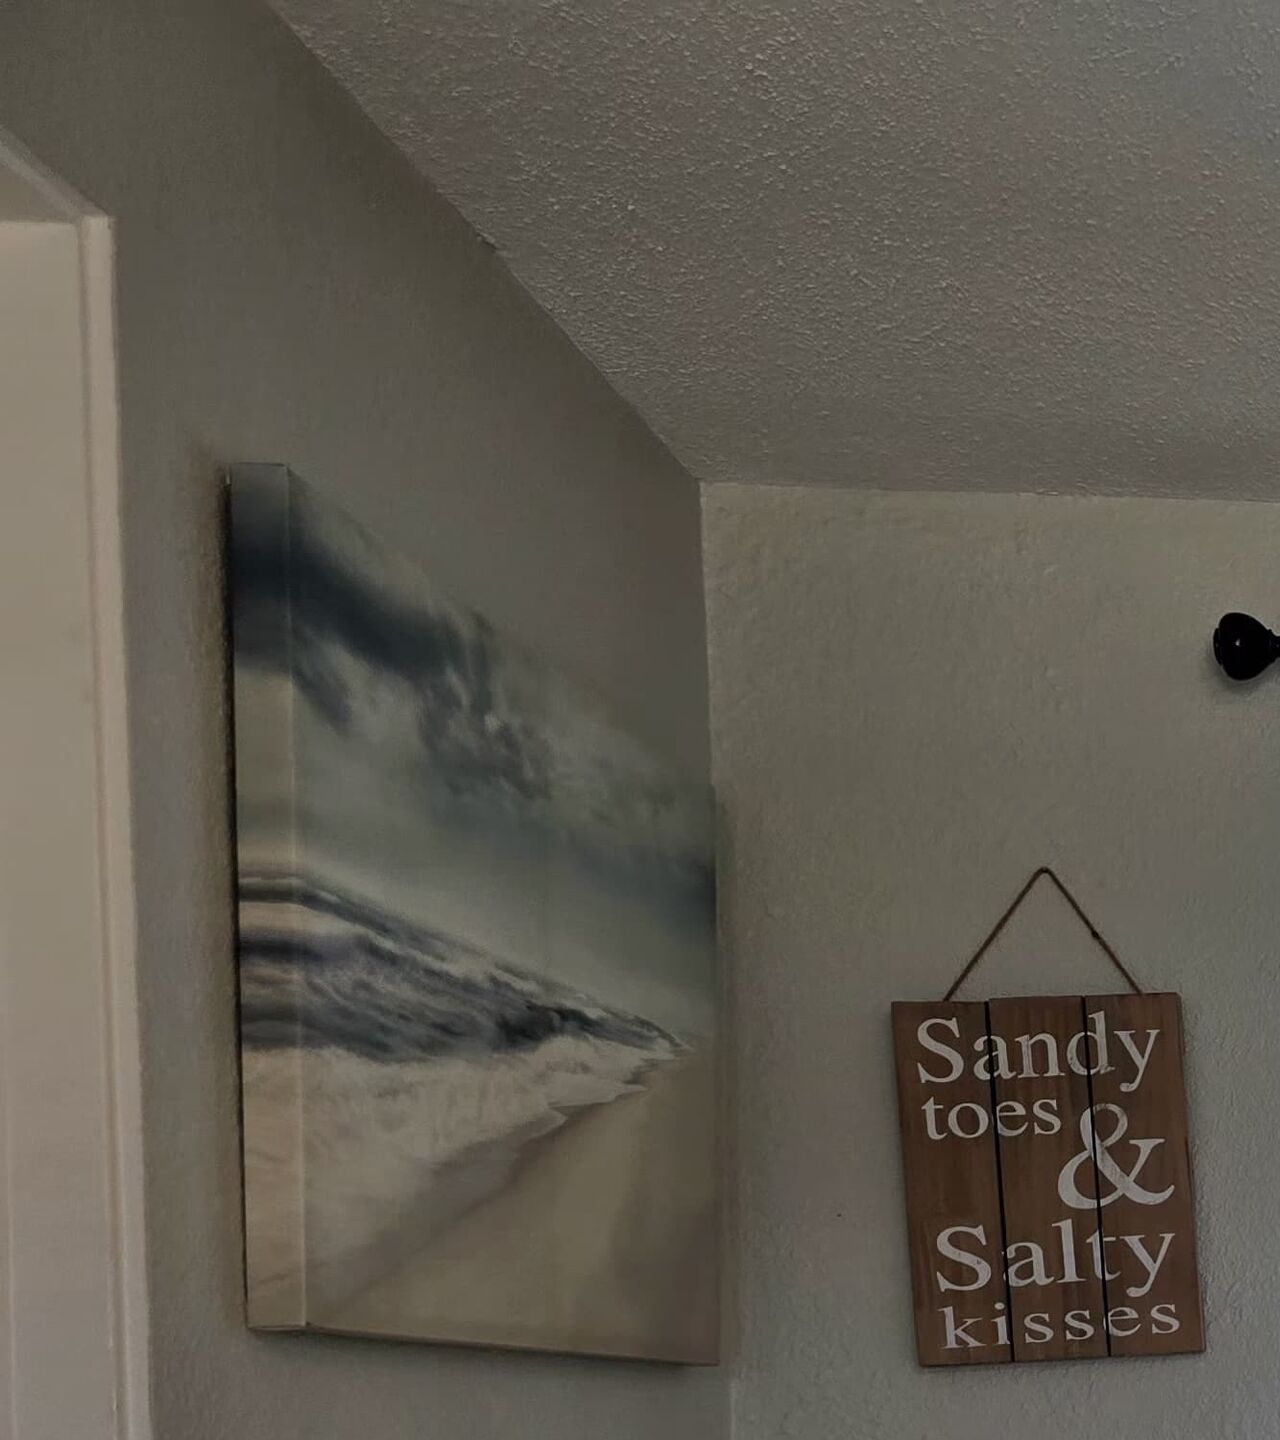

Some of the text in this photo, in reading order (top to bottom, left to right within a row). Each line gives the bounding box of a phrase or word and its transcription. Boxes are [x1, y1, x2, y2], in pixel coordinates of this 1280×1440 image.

[916, 1010, 1161, 1093] Sandy
[921, 1095, 1062, 1141] toes
[1057, 1103, 1175, 1210] &
[935, 1218, 1176, 1298] Salty
[937, 1302, 1181, 1350] kisses
